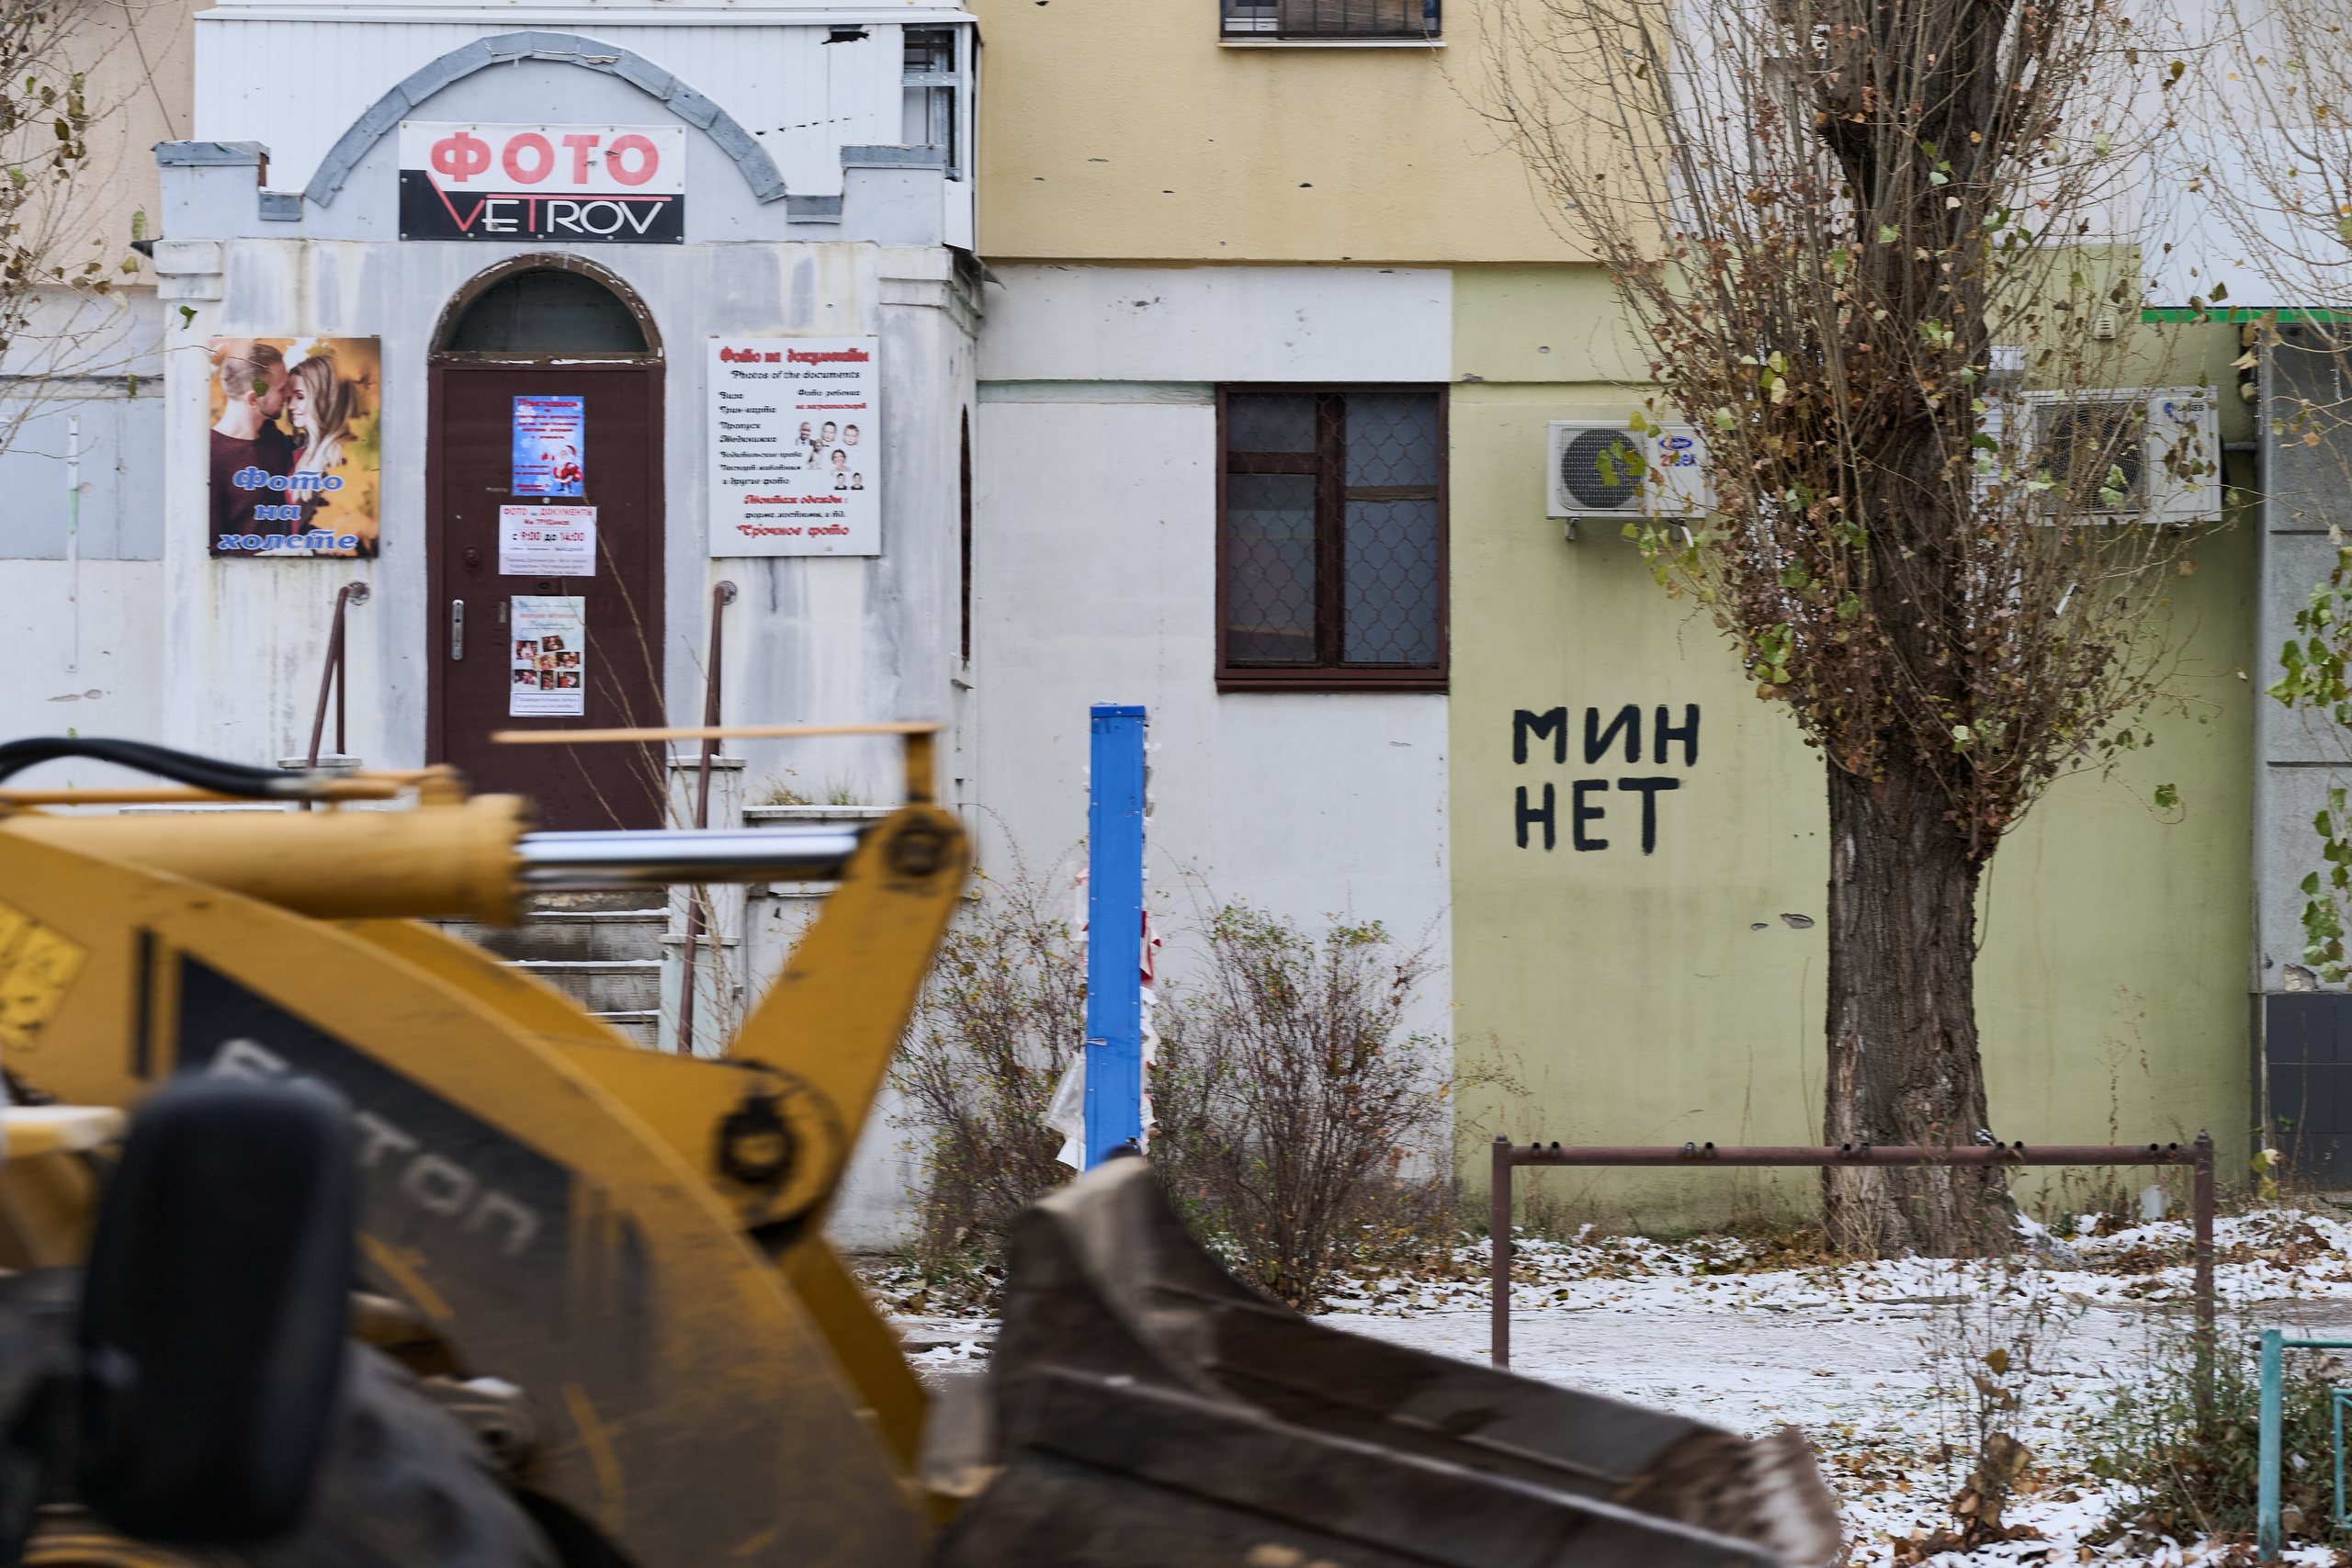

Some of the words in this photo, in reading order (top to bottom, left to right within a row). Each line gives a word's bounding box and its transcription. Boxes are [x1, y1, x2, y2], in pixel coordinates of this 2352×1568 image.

[430, 131, 660, 186] ФОТО
[425, 171, 672, 234] VETROV
[720, 346, 761, 363] Фото
[764, 353, 781, 363] на
[787, 347, 869, 366] документы
[730, 370, 769, 379] Photos
[771, 370, 782, 379] of
[783, 370, 800, 379] the
[802, 370, 861, 379] documents
[718, 421, 761, 431] Пропуск
[232, 466, 345, 491] Фото
[730, 478, 761, 487] другие
[763, 477, 790, 487] фото
[254, 504, 302, 521] на
[503, 507, 528, 516] ФОТО
[539, 507, 594, 516] ДОКУМЕНТЫ
[217, 529, 359, 550] холсте
[512, 533, 518, 541] с
[521, 531, 542, 541] 9:00
[544, 533, 558, 542] до
[560, 531, 586, 542] 14:00
[736, 525, 803, 538] Срочное
[808, 524, 850, 538] фото
[1513, 703, 1701, 767] МИН
[1515, 776, 1681, 856] НЕТ
